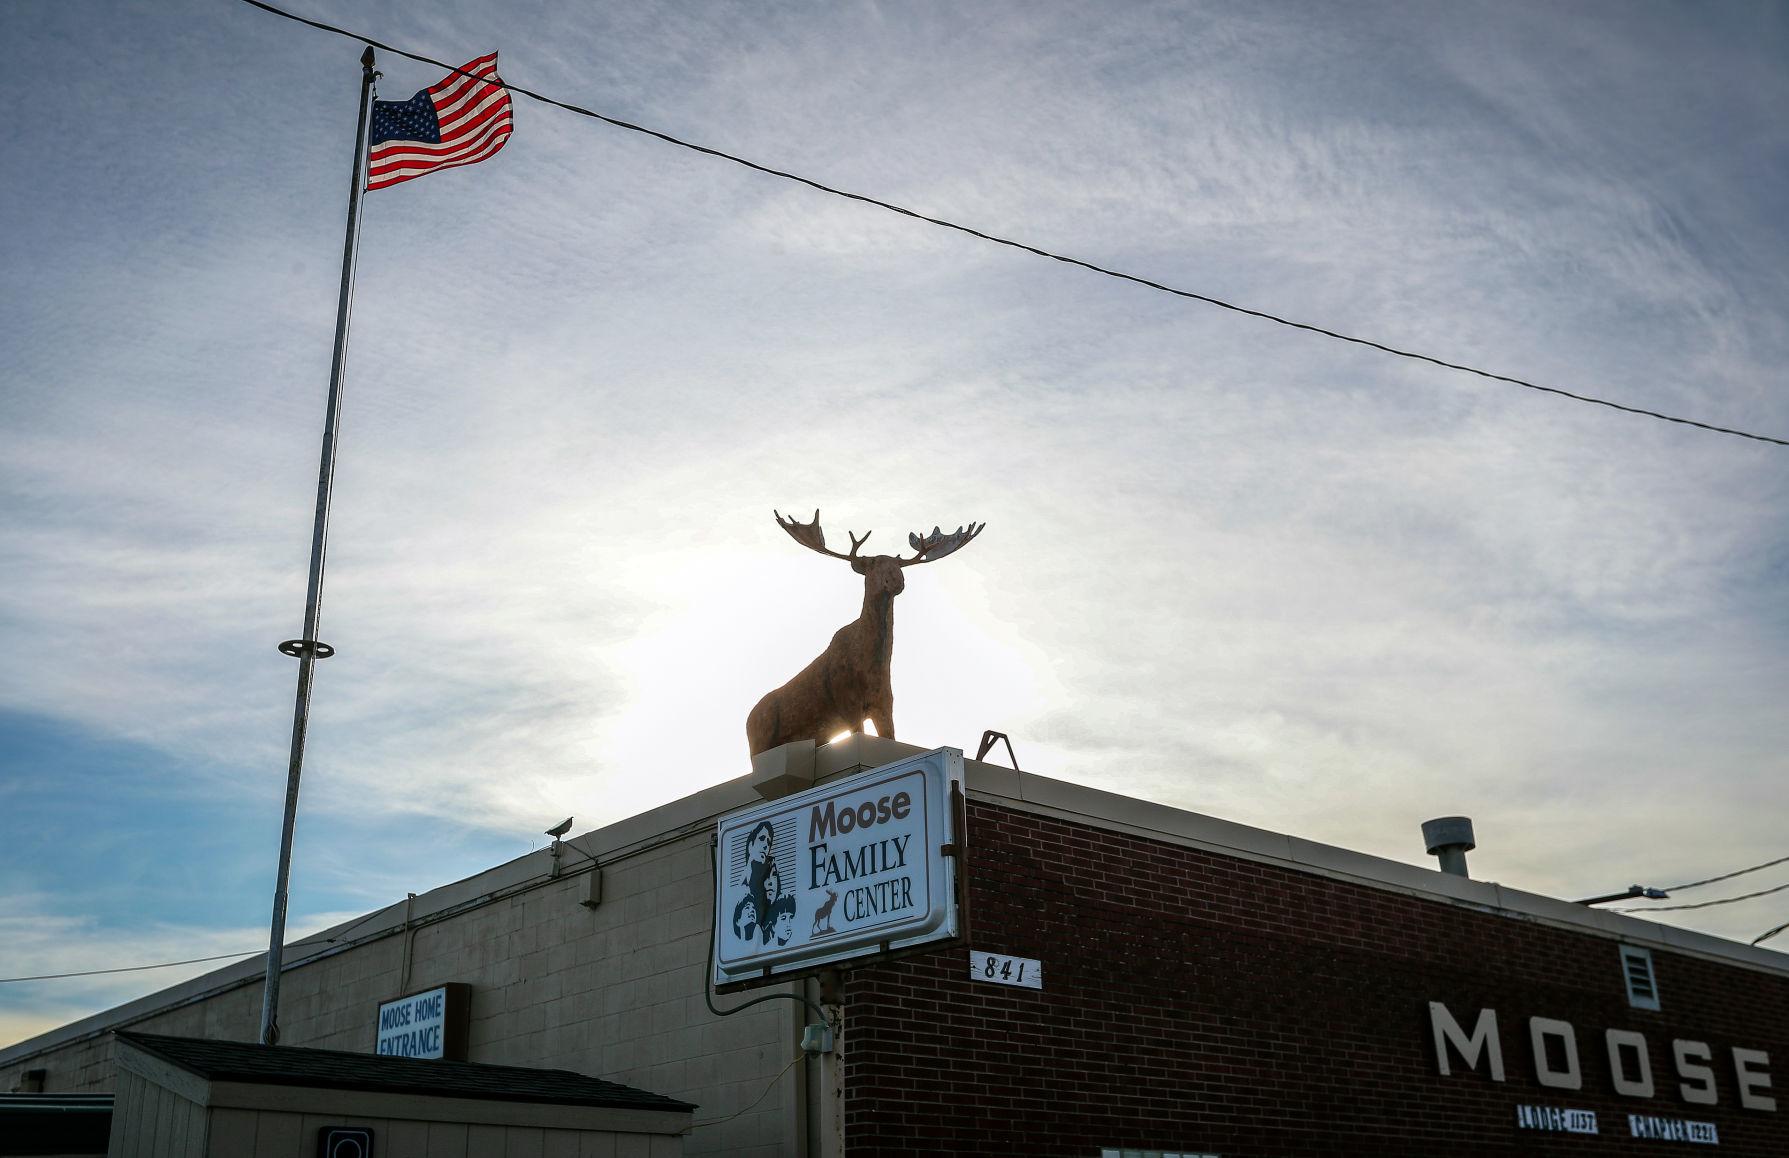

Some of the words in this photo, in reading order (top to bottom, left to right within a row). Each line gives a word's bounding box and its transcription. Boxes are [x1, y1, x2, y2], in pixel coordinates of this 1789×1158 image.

[808, 791, 911, 843] Moose
[808, 834, 911, 890] FAMILY
[843, 876, 914, 922] CENTER
[984, 956, 1025, 982] 841
[381, 1002, 411, 1031] MOOSE
[415, 994, 442, 1022] HOME
[380, 1025, 440, 1057] ENTRANCE
[1429, 1001, 1777, 1112] MOOSE
[1521, 1105, 1567, 1131] LODGE
